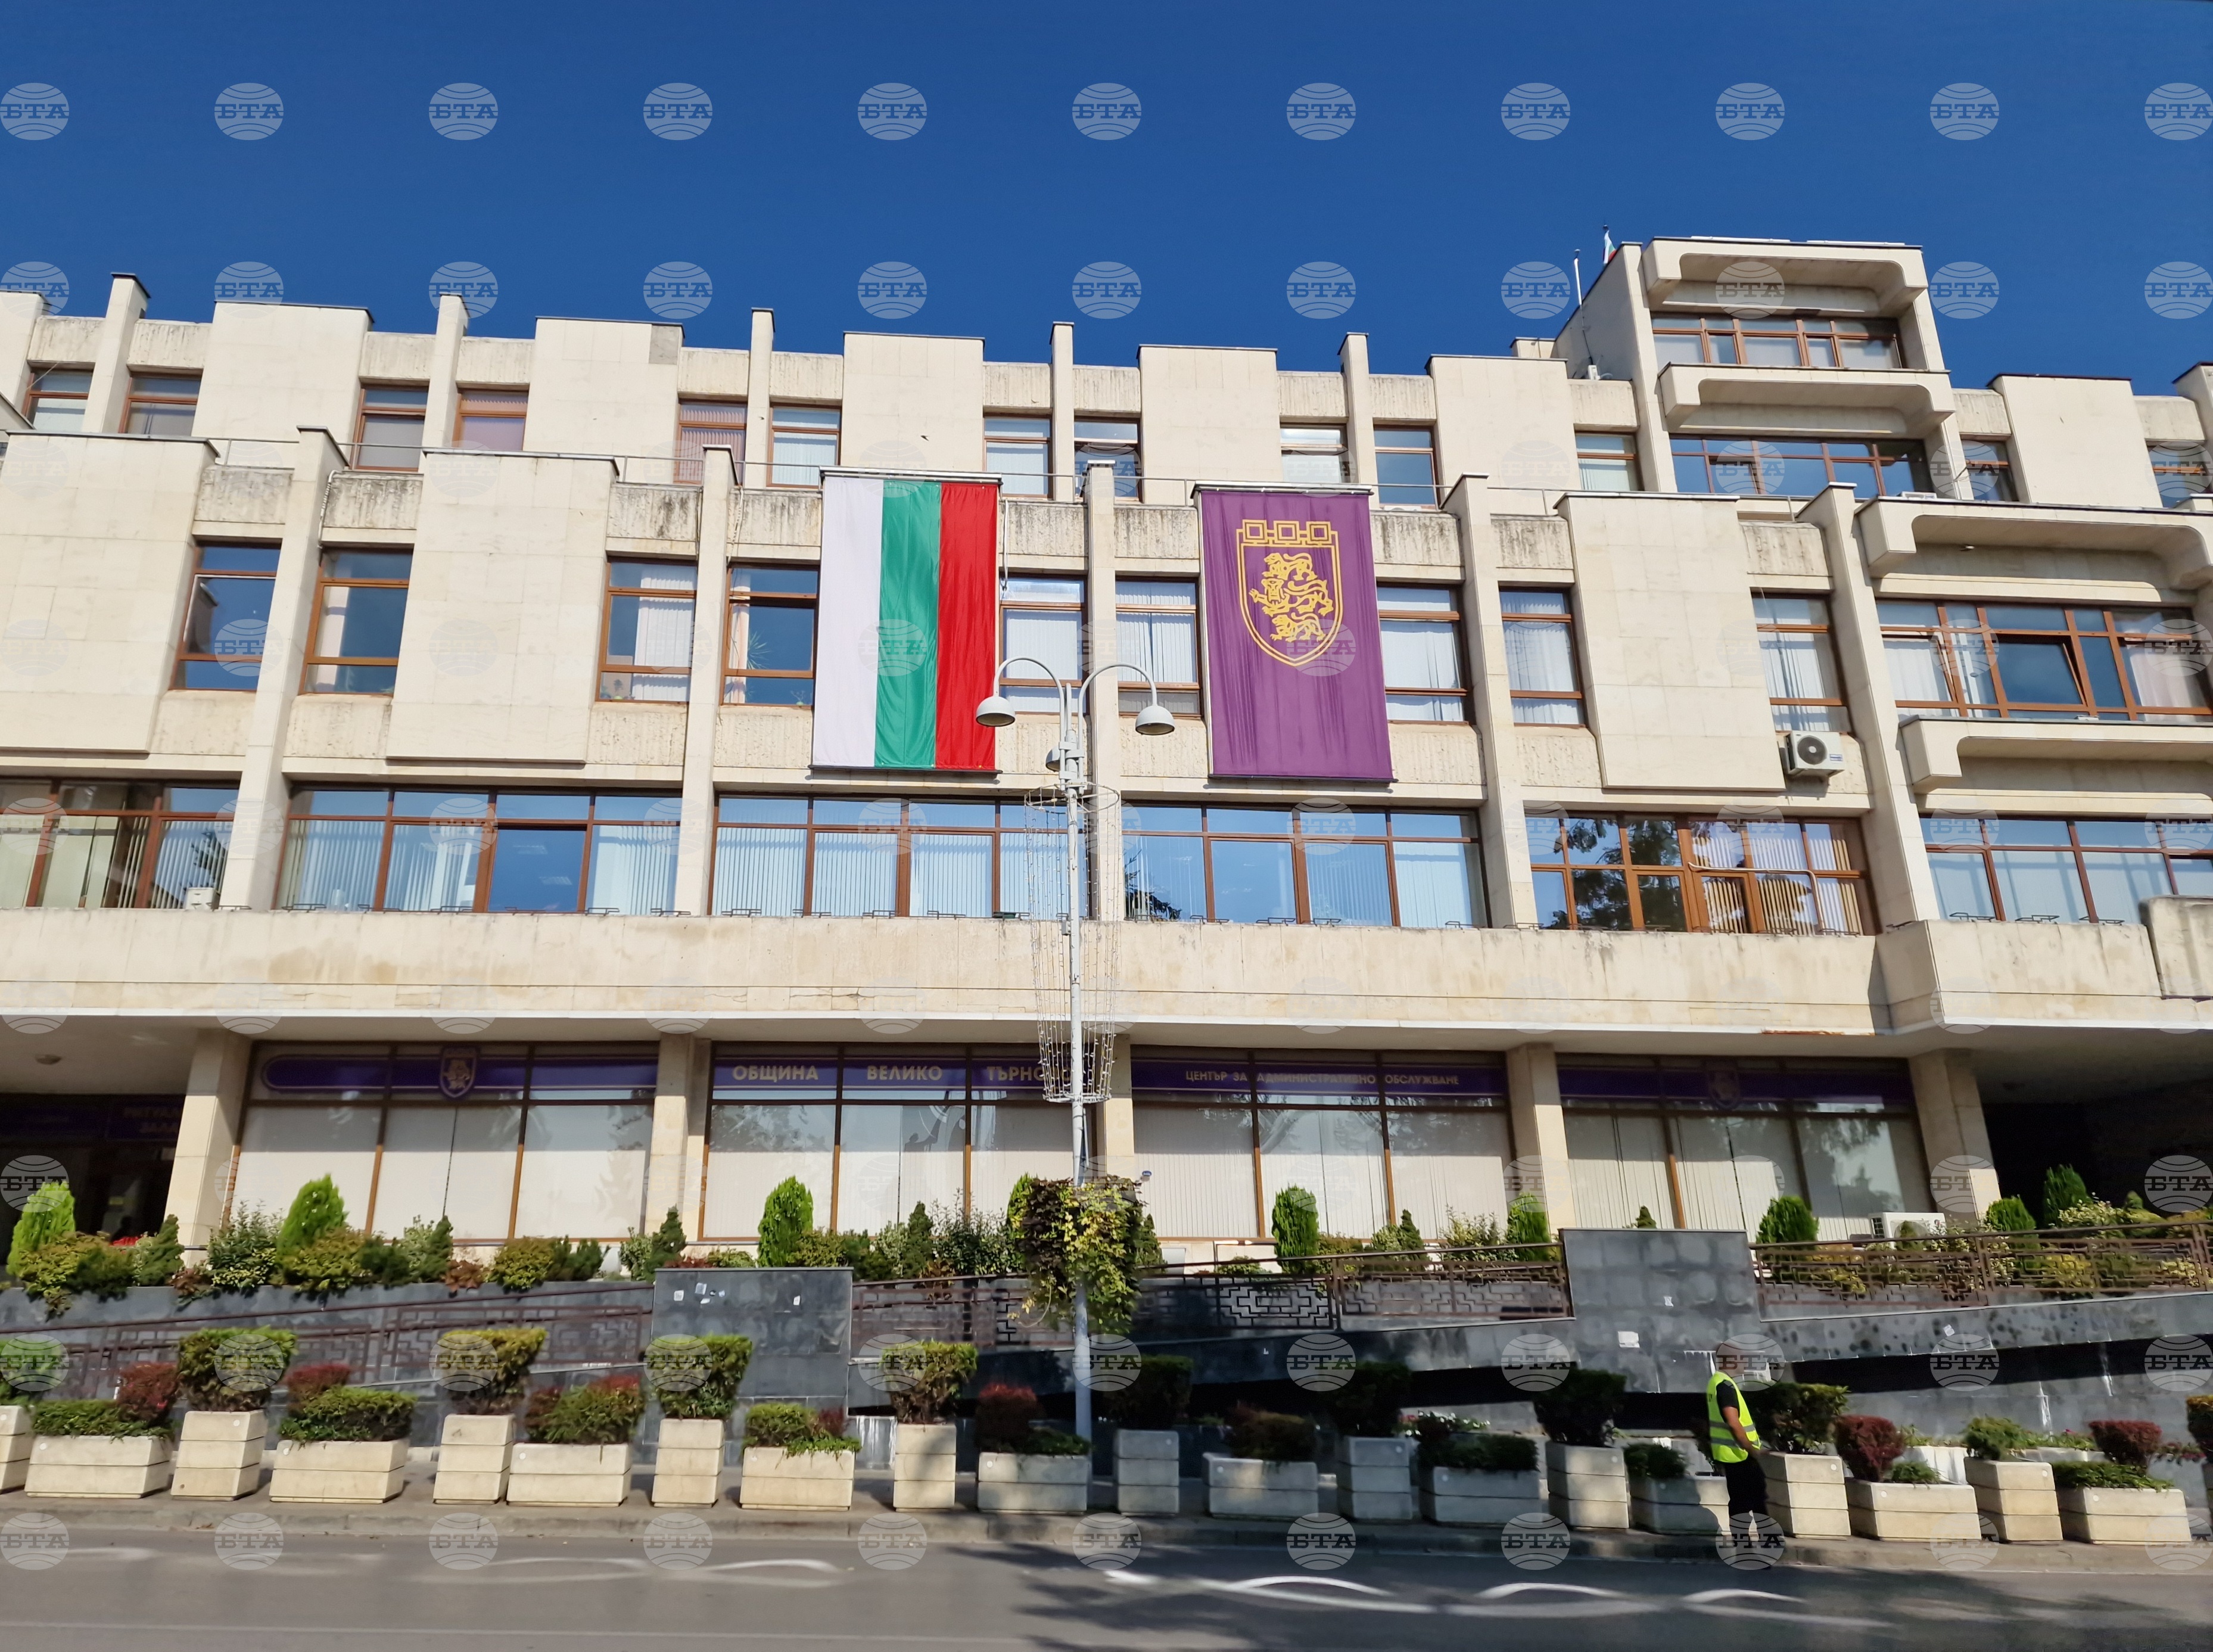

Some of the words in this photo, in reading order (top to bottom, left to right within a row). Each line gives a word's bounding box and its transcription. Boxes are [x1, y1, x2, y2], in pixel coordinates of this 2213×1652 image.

[732, 1065, 819, 1082] ОБЩИНА
[867, 1065, 943, 1081] ВЕЛИКО
[1185, 1071, 1228, 1081] ЦЕНТЪР
[1232, 1072, 1248, 1081] ЗА
